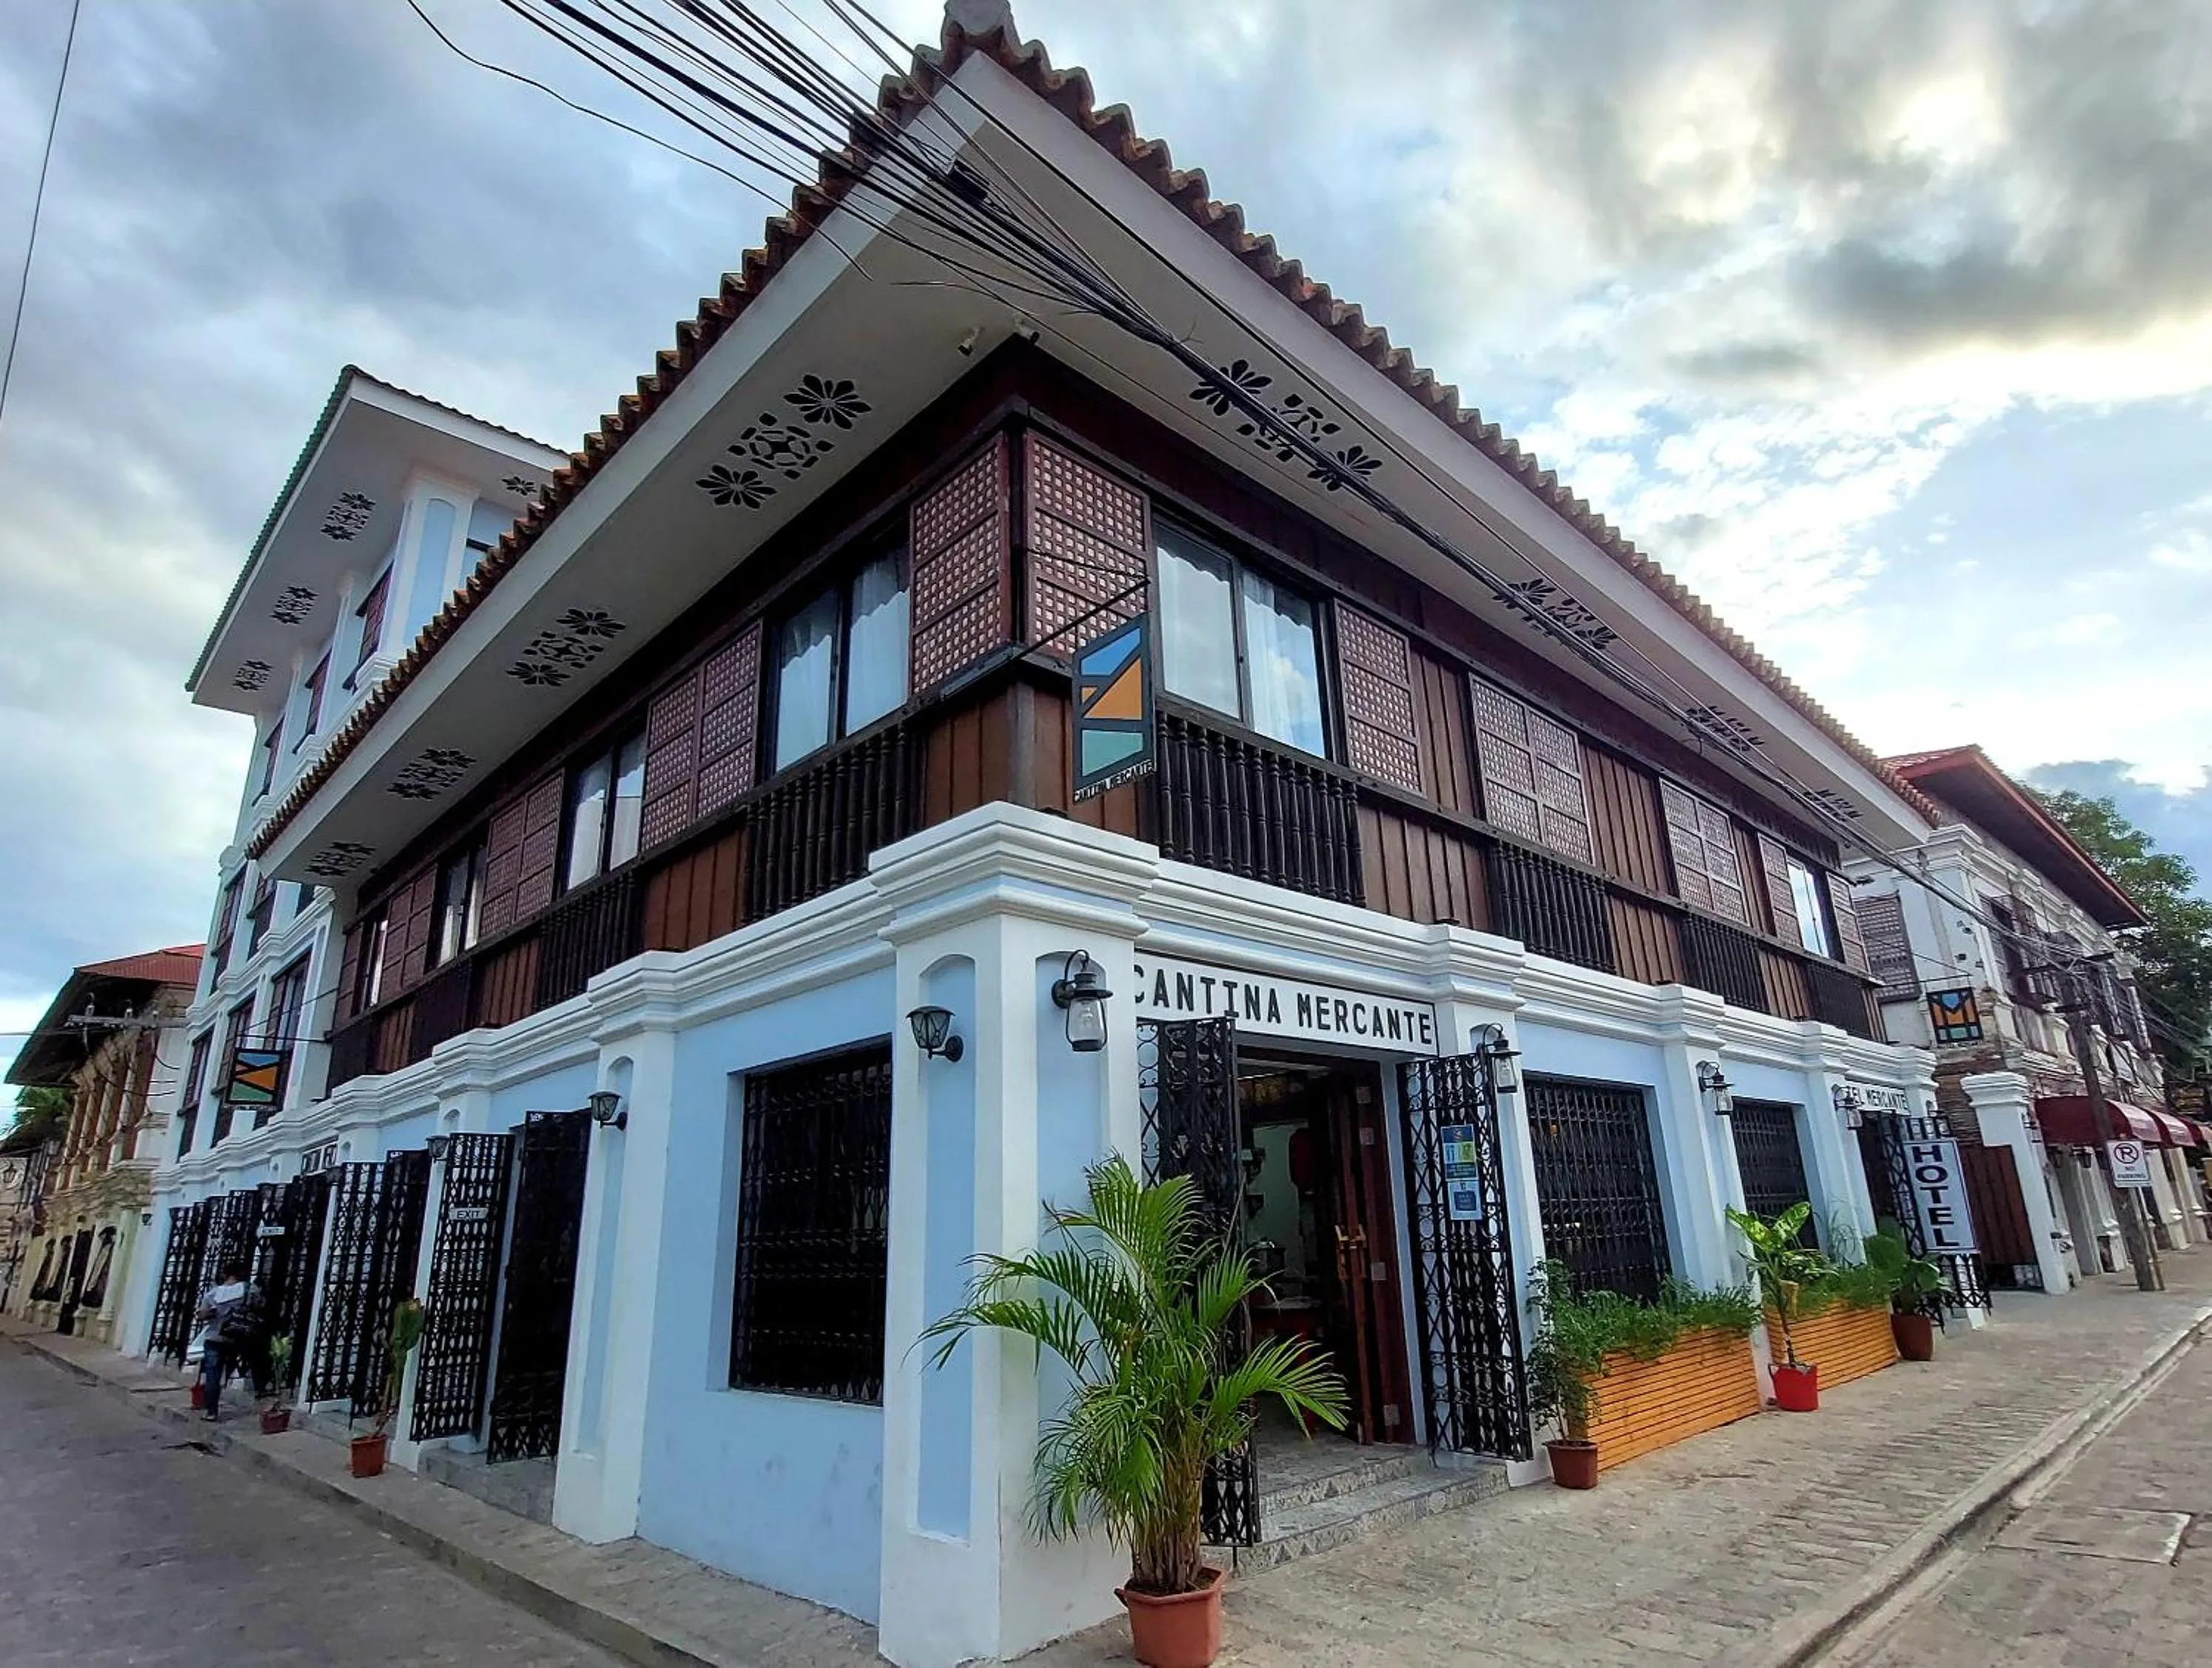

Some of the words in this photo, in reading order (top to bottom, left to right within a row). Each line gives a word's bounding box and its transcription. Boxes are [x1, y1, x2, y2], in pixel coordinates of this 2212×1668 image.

[1297, 993, 1432, 1044] MERCANTE
[456, 1210, 481, 1221] EXIT
[1911, 1144, 1959, 1247] HOTEL
